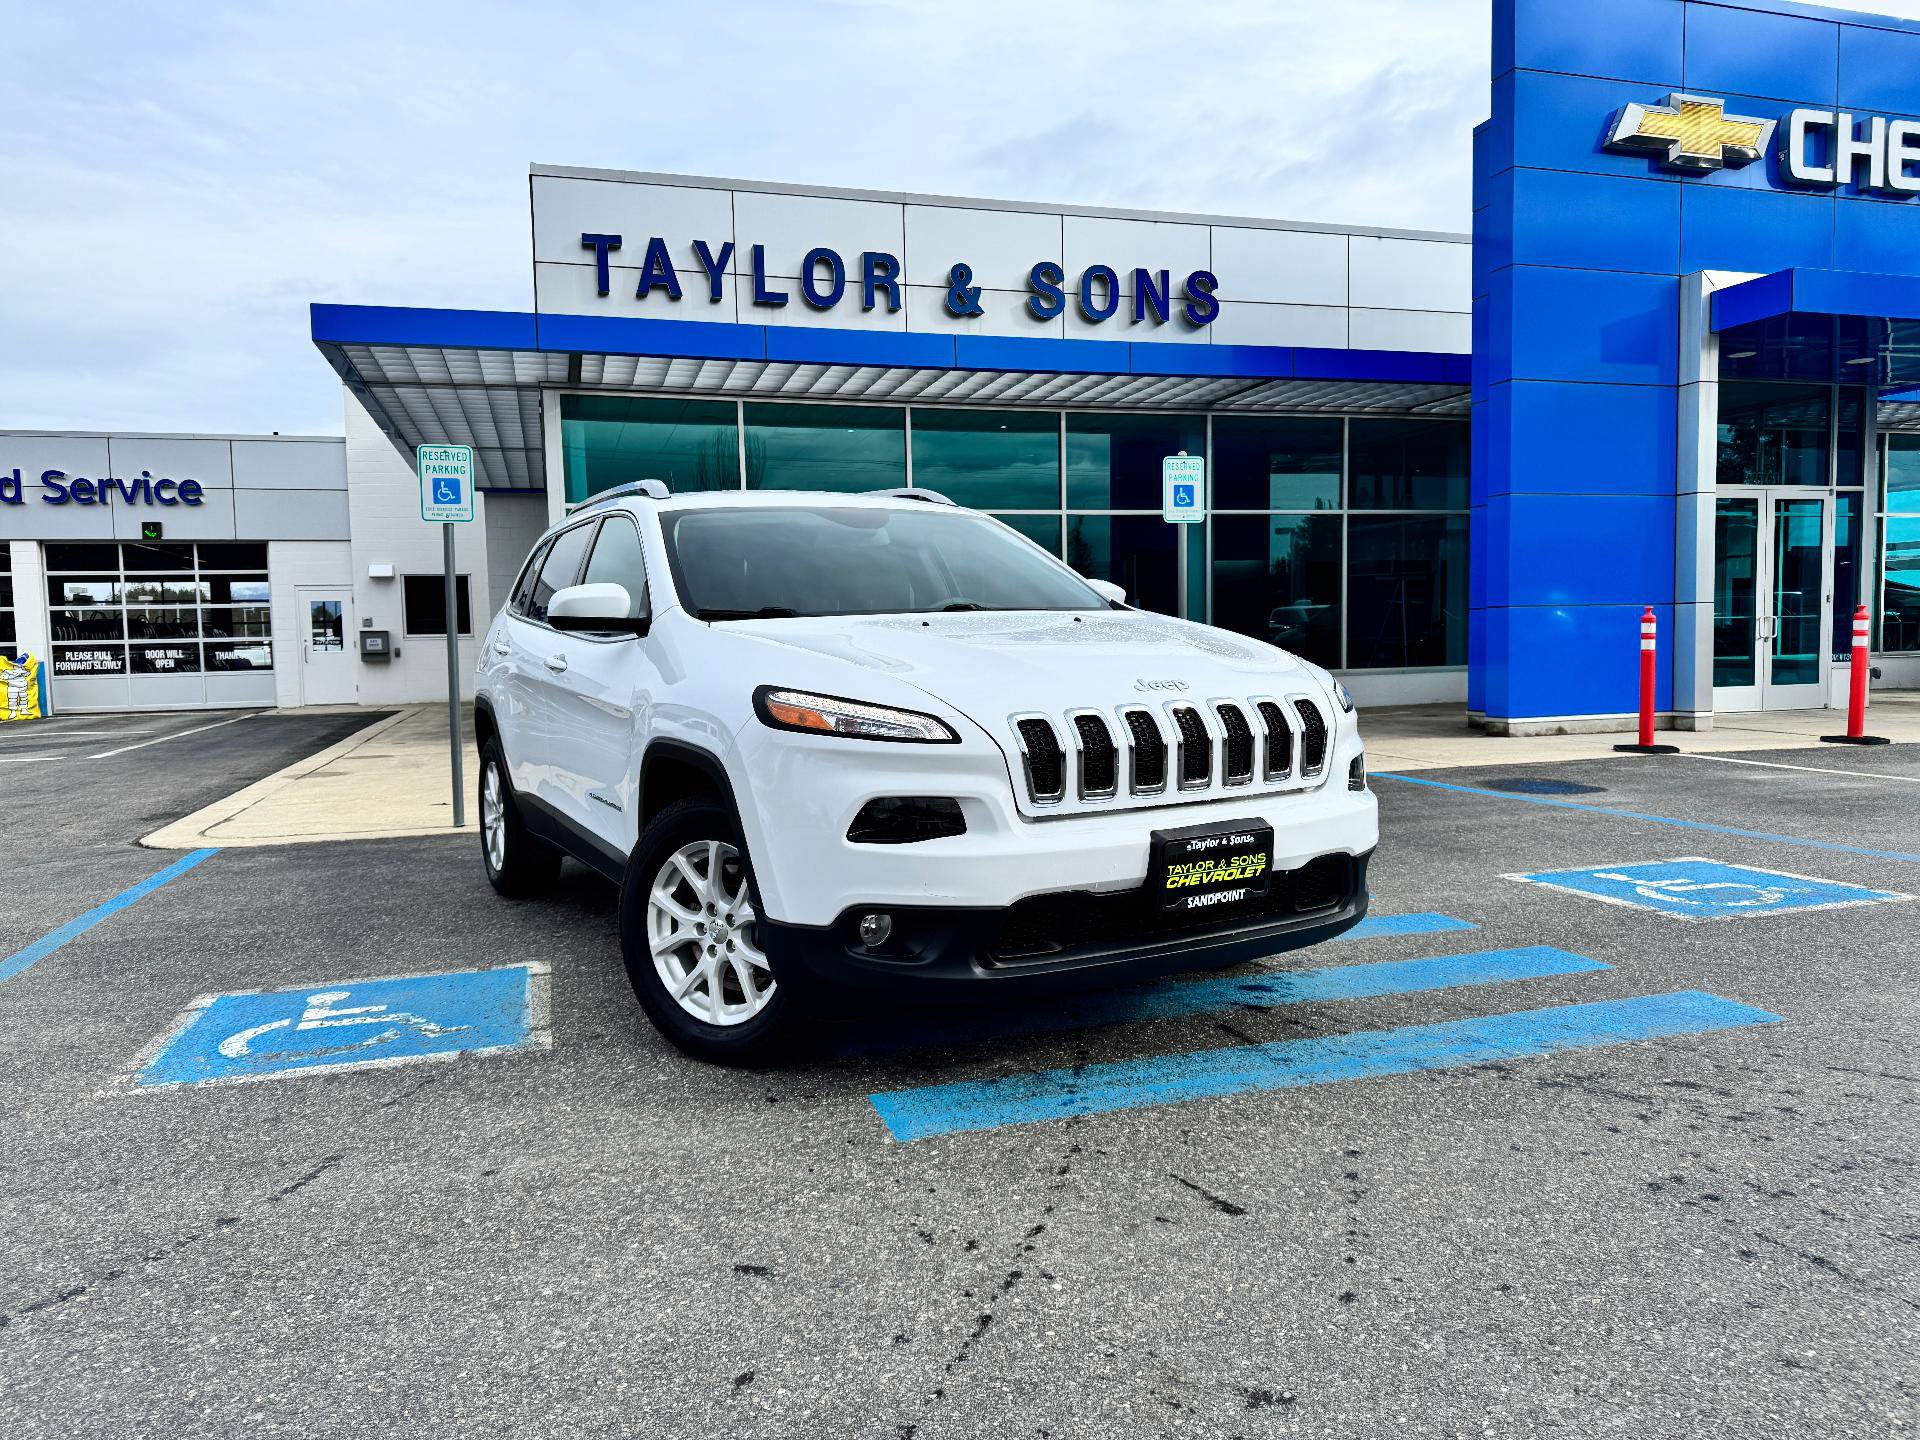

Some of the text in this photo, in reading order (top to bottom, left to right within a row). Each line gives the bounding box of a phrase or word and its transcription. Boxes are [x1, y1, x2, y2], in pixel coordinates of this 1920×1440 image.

[580, 232, 1221, 328] TAYLOR & SONS
[422, 450, 468, 462] RESERVED
[425, 464, 466, 475] PARKING
[1167, 462, 1200, 471] RESERVED
[1168, 473, 1199, 482] PARKING
[40, 469, 204, 505] Service
[65, 651, 113, 661] PLEASE PULL
[145, 649, 185, 659] DOOR WILL
[55, 660, 122, 671] FORWARD SLOWLY
[155, 659, 175, 668] OPEN
[1133, 678, 1190, 692] Jeep
[1190, 834, 1251, 851] Taylor & Sons
[1167, 853, 1267, 876] TAYLOR & SONS
[1166, 864, 1267, 889] CHEVROLET
[1187, 889, 1246, 909] SANDPOINT
